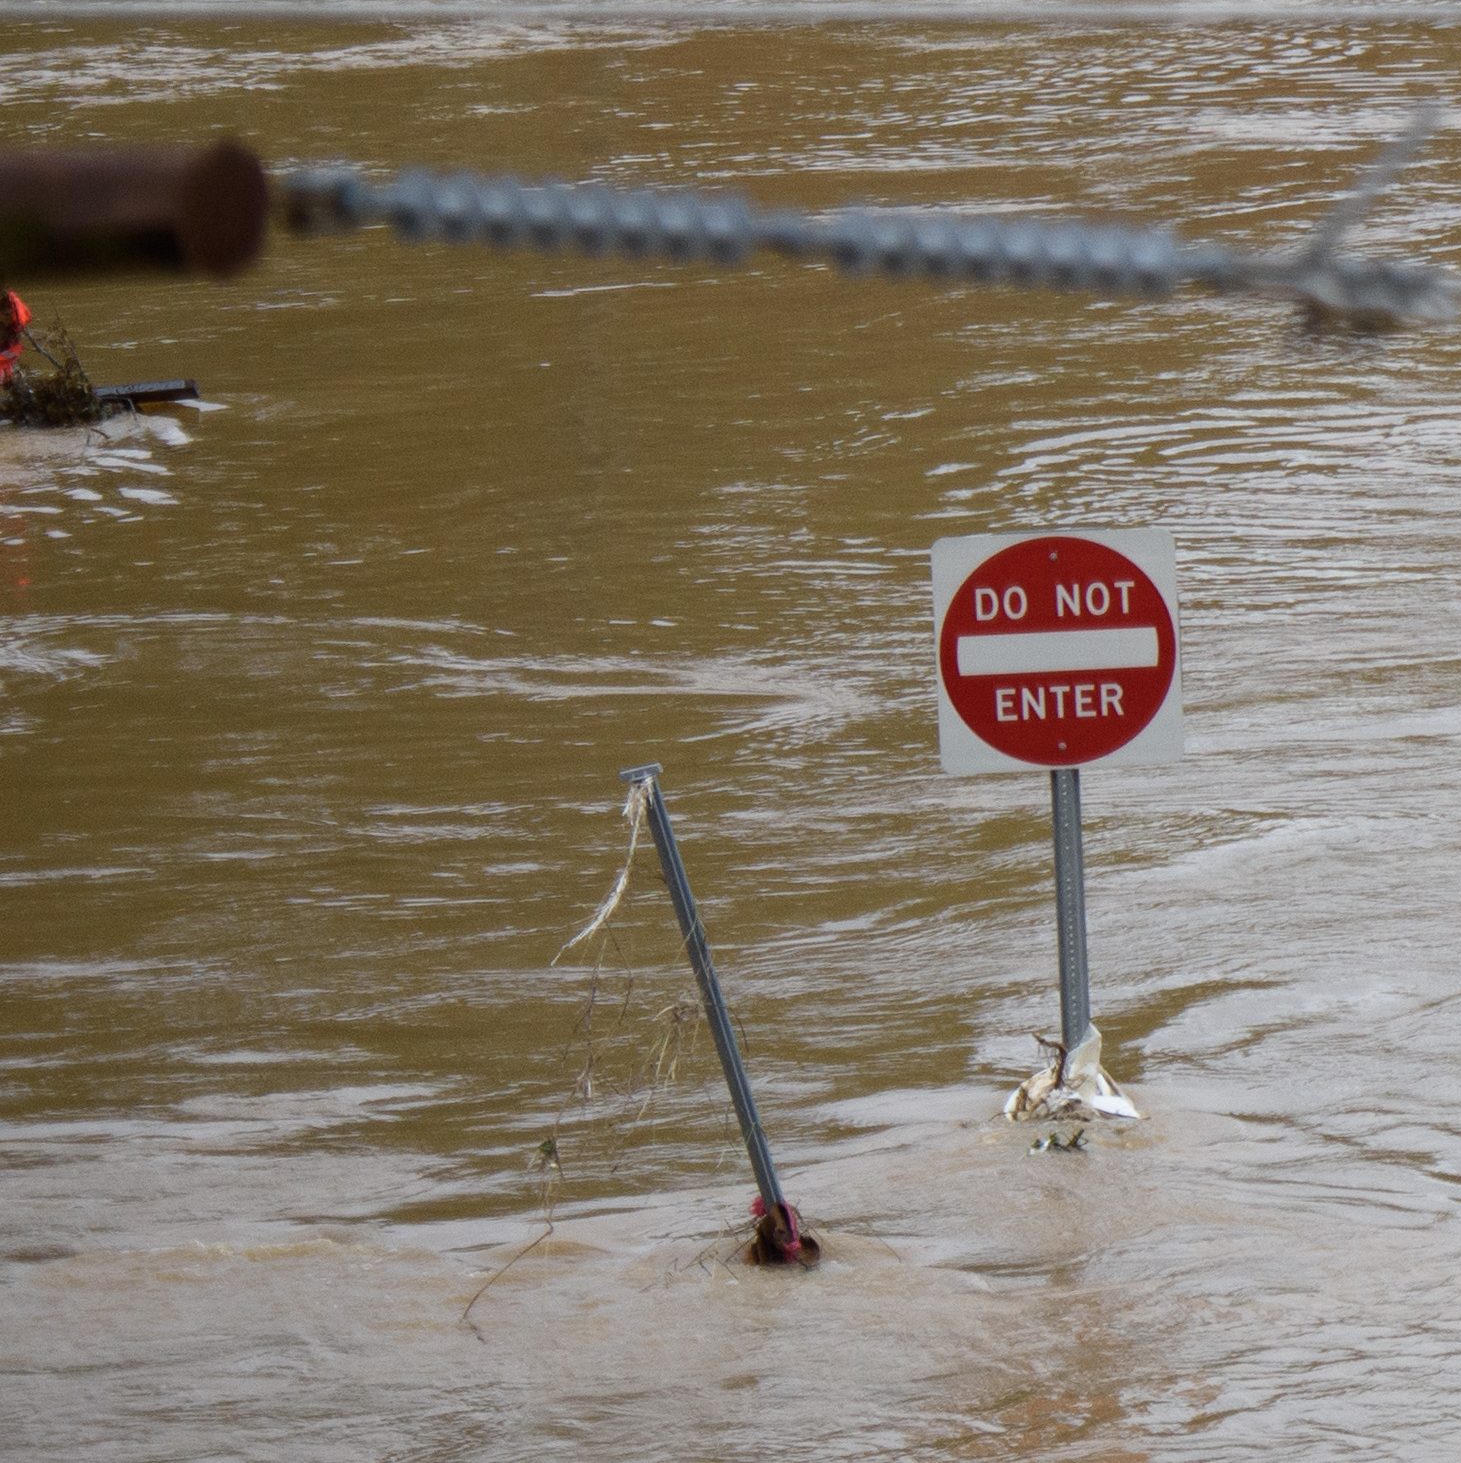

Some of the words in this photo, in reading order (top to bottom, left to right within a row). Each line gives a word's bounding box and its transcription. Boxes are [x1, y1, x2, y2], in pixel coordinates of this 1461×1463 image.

[974, 586, 1028, 622] DO
[1055, 581, 1136, 617] NOT
[994, 683, 1125, 723] ENTER
